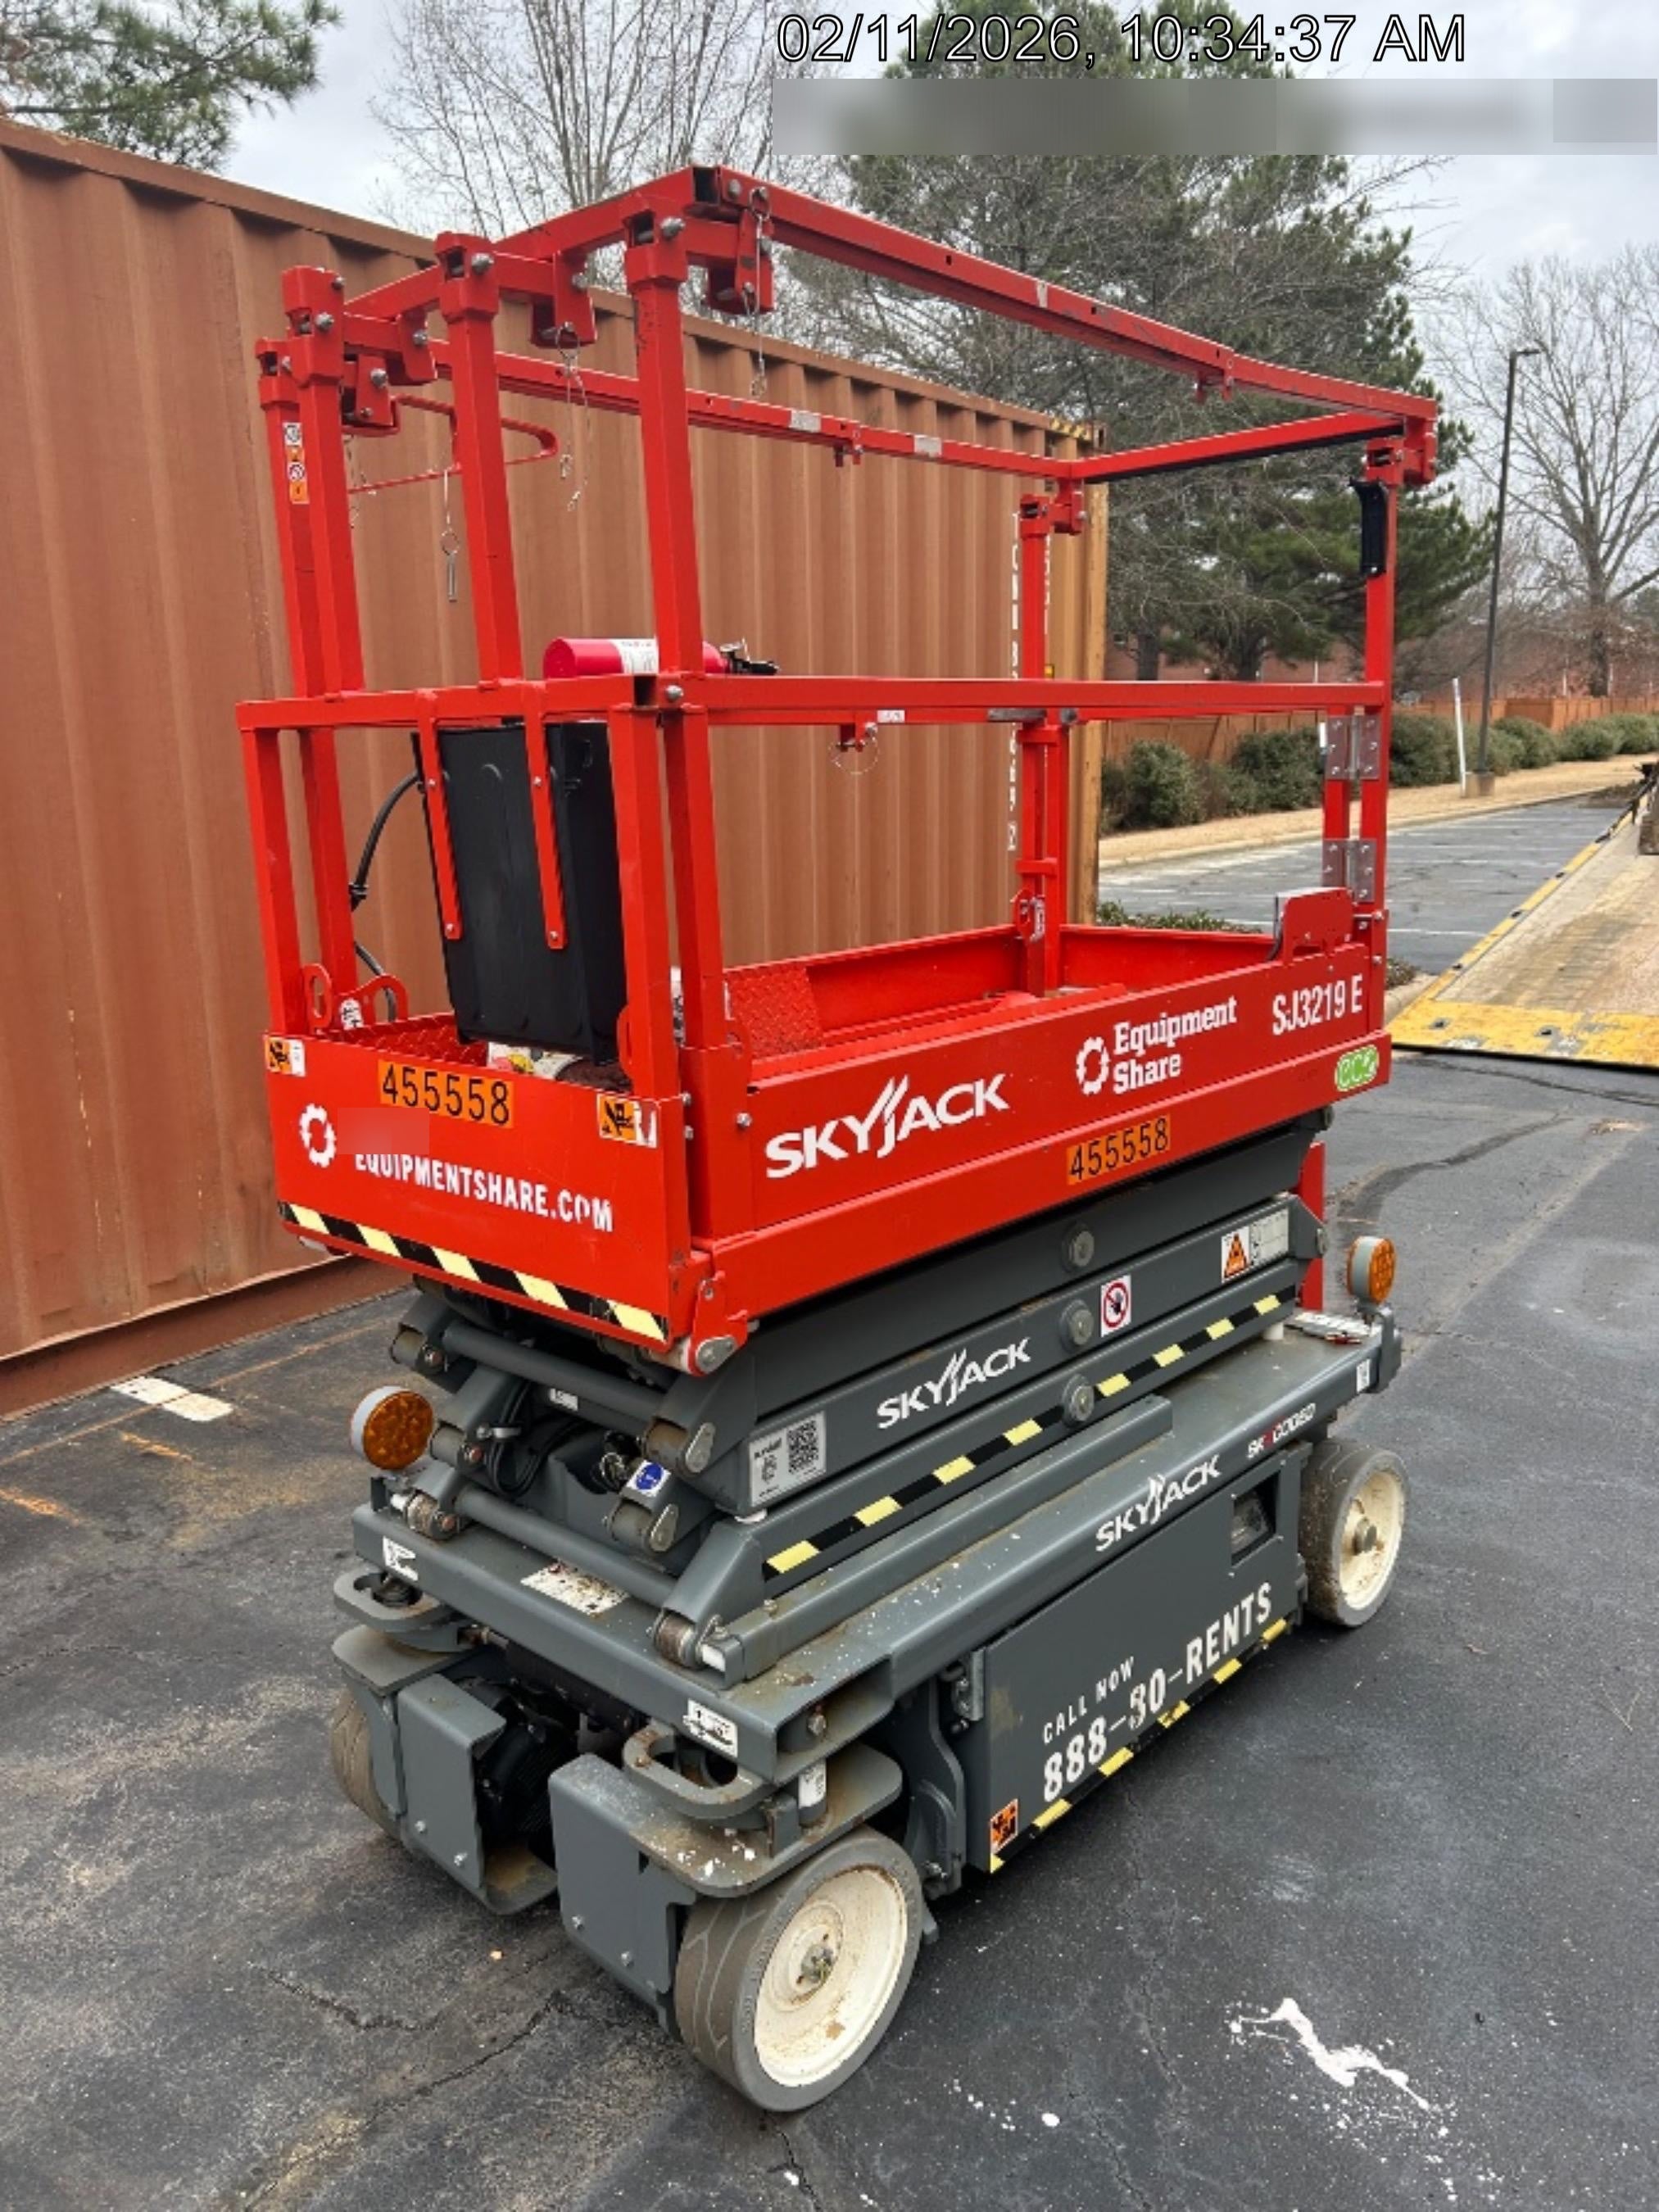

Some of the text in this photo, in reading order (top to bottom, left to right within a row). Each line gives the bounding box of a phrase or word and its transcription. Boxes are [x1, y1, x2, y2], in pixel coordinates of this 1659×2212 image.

[1113, 996, 1237, 1057] Equipment
[1272, 980, 1346, 1036] SJ3219
[383, 1065, 509, 1125] 455558
[1113, 1052, 1182, 1095] Share
[765, 1073, 1009, 1179] SKYJACK
[1070, 1117, 1169, 1181] 455558
[877, 1338, 1031, 1430] SKYJACK
[1095, 1455, 1222, 1553] SKYJACK
[1042, 1581, 1272, 1802] 888-30-RENTS
[1042, 1655, 1135, 1745] CALL NOW
